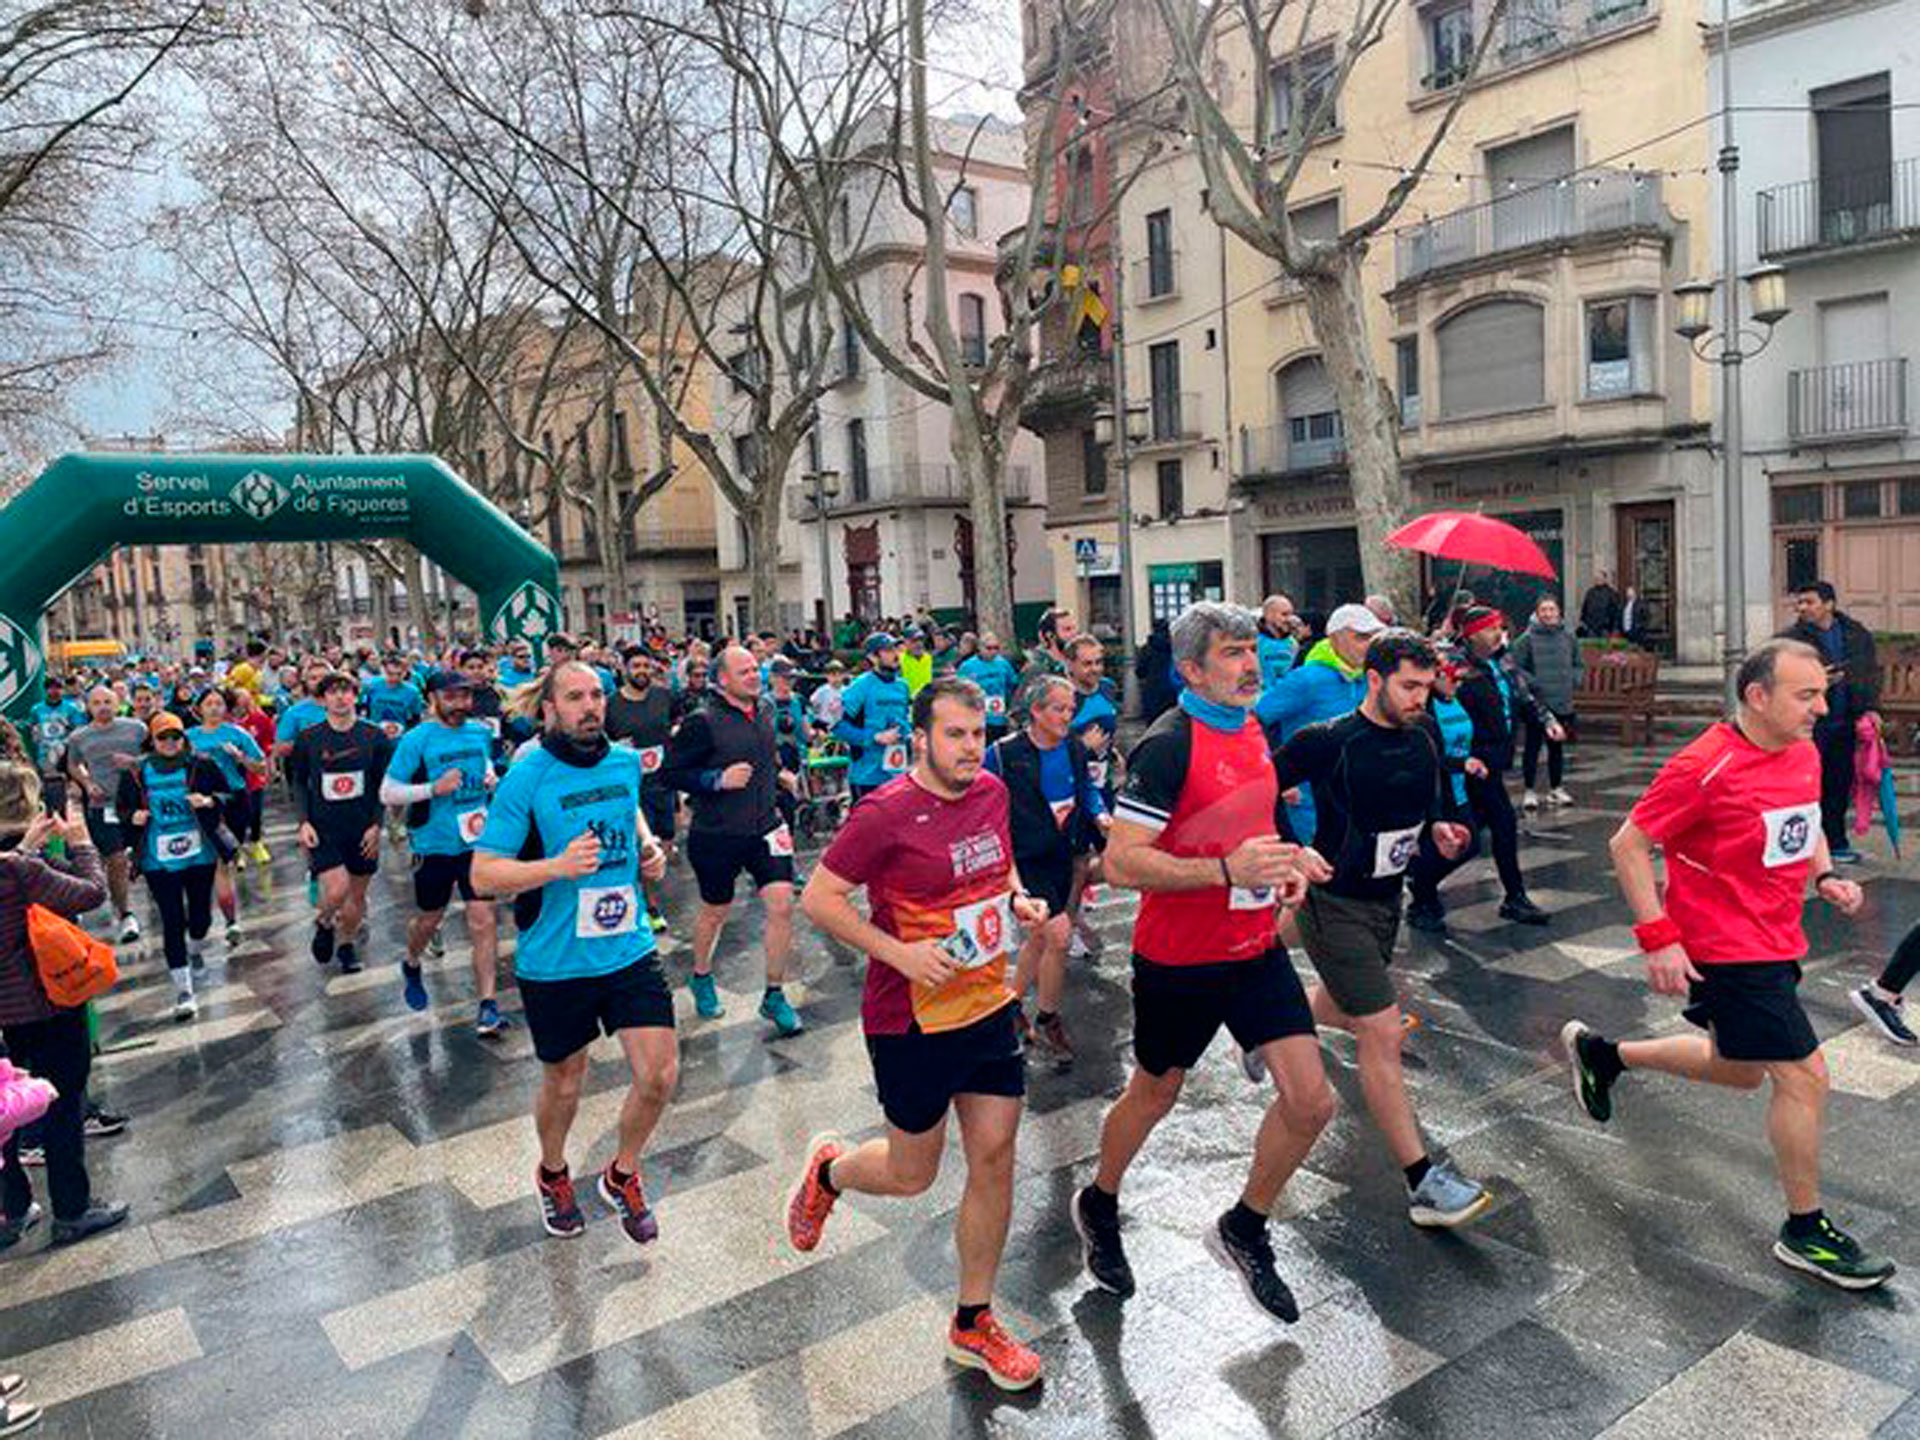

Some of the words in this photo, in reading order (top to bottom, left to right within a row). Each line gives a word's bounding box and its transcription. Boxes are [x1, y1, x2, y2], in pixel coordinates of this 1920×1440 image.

[136, 472, 209, 491] Servei
[291, 474, 407, 493] Ajuntament
[123, 496, 231, 519] d'Esports
[294, 496, 319, 512] de
[327, 495, 408, 516] Figueres
